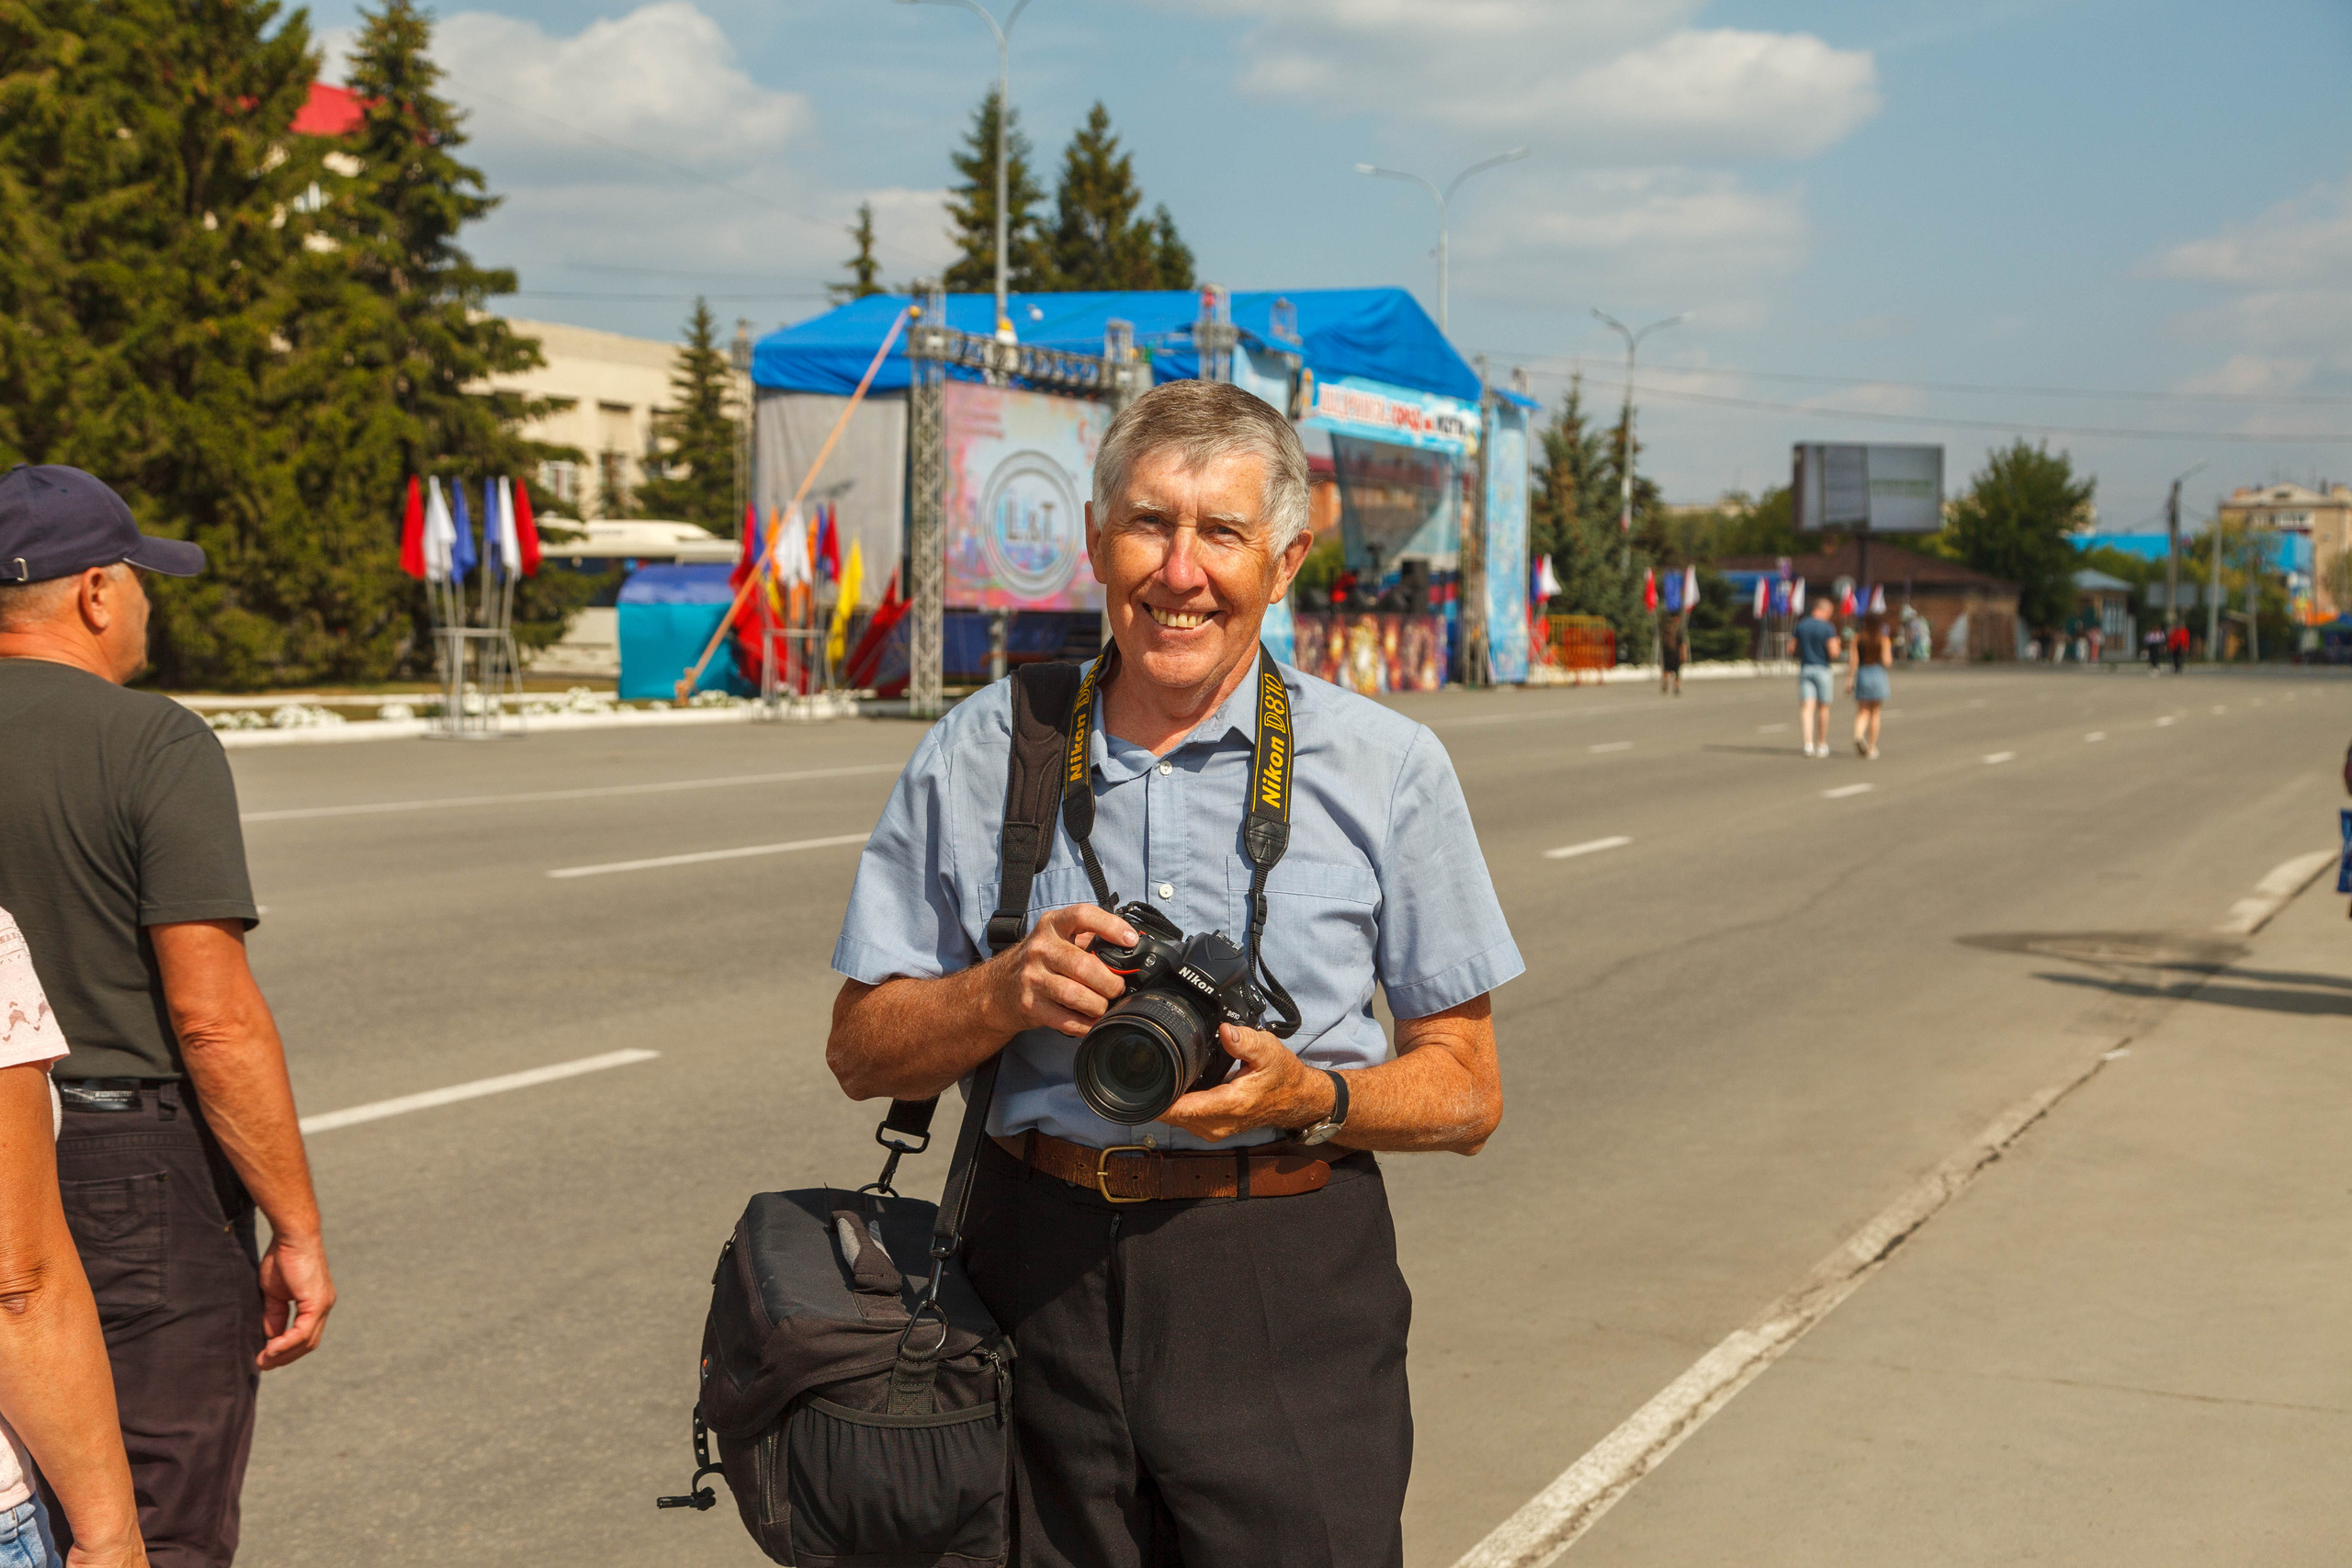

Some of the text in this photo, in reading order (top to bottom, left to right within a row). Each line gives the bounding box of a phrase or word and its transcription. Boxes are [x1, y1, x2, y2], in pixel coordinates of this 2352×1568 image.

[1070, 713, 1087, 781] Nikon
[1262, 672, 1286, 808] Nikon D810
[1178, 966, 1215, 995] Nikon
